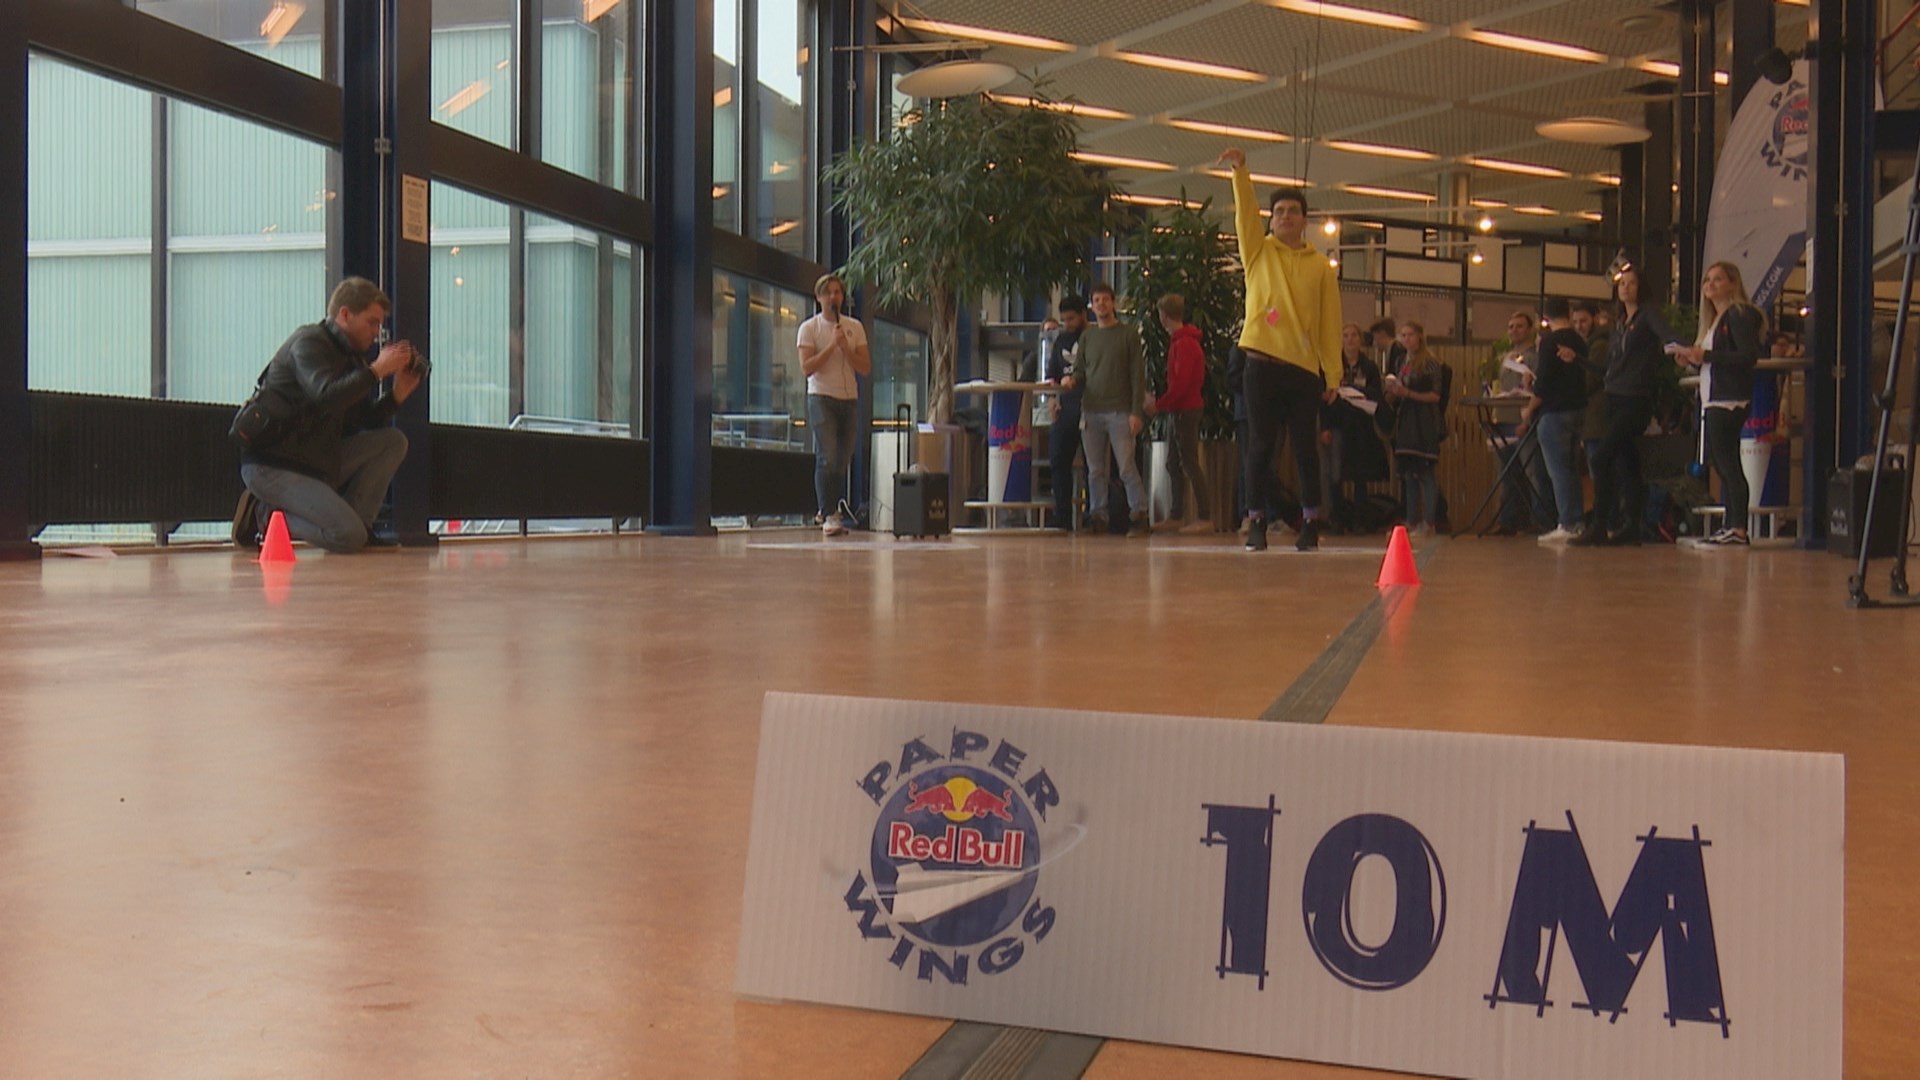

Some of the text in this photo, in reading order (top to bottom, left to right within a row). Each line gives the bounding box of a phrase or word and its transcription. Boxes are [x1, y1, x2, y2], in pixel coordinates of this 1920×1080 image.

[856, 725, 1060, 823] PAPER
[889, 821, 1024, 868] Red Bull
[843, 869, 1056, 986] WINGS
[1200, 793, 1731, 1038] 10 M
